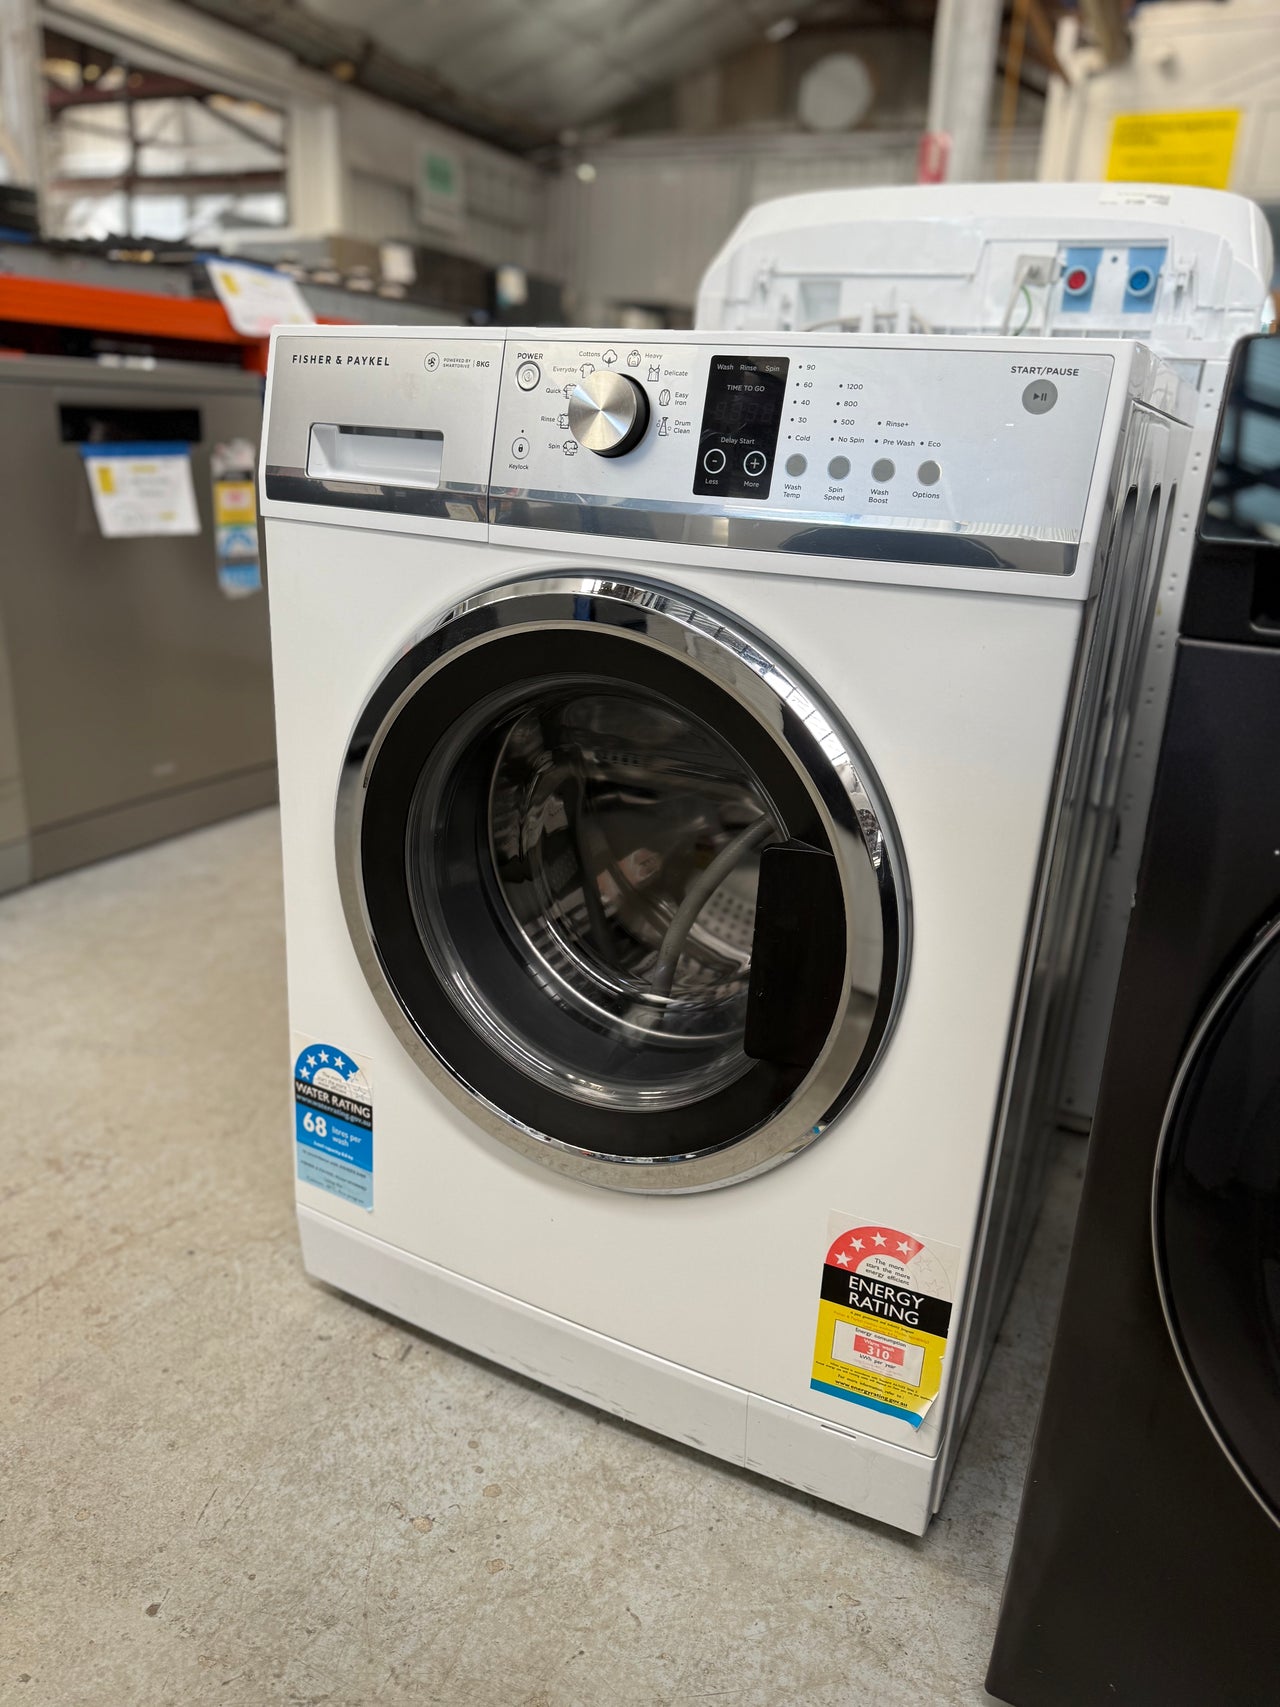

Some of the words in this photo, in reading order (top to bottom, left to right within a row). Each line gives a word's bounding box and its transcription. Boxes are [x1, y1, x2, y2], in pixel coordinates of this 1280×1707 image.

[517, 352, 544, 360] POWER
[578, 350, 600, 358] Cottons
[645, 352, 663, 360] Heavy
[292, 354, 332, 365] FISHER
[335, 355, 343, 365] &
[346, 356, 390, 366] PAYKEL
[476, 360, 490, 368] 8KG
[552, 366, 578, 374] Everyday
[717, 363, 734, 371] Wash
[1010, 365, 1080, 377] START/PAUSE
[663, 369, 689, 377] Delicate
[545, 387, 561, 395] Quick
[674, 391, 689, 400] Easy
[840, 418, 855, 426] 500
[886, 420, 909, 428] Rinse+
[720, 436, 739, 445] Delay
[740, 437, 755, 445] Start
[795, 434, 811, 442] Cold
[849, 436, 865, 444] Spin
[548, 442, 561, 450] Spin
[896, 439, 915, 447] Wash
[927, 440, 941, 448] Eco
[508, 463, 529, 471] Keylock
[784, 483, 802, 491] Wash
[828, 486, 843, 494] Spin
[870, 488, 889, 496] Wash
[912, 490, 940, 500] Options
[824, 494, 845, 502] Speed
[296, 1081, 331, 1104] WATER
[331, 1095, 371, 1118] RATING
[303, 1111, 328, 1138] 68
[874, 1257, 886, 1266] The
[888, 1263, 905, 1272] more
[865, 1268, 884, 1279] energy
[894, 1271, 911, 1280] more
[848, 1275, 925, 1310] ENERGY
[848, 1291, 919, 1325] RATING
[855, 1327, 872, 1337] Energy
[866, 1345, 890, 1360] 310
